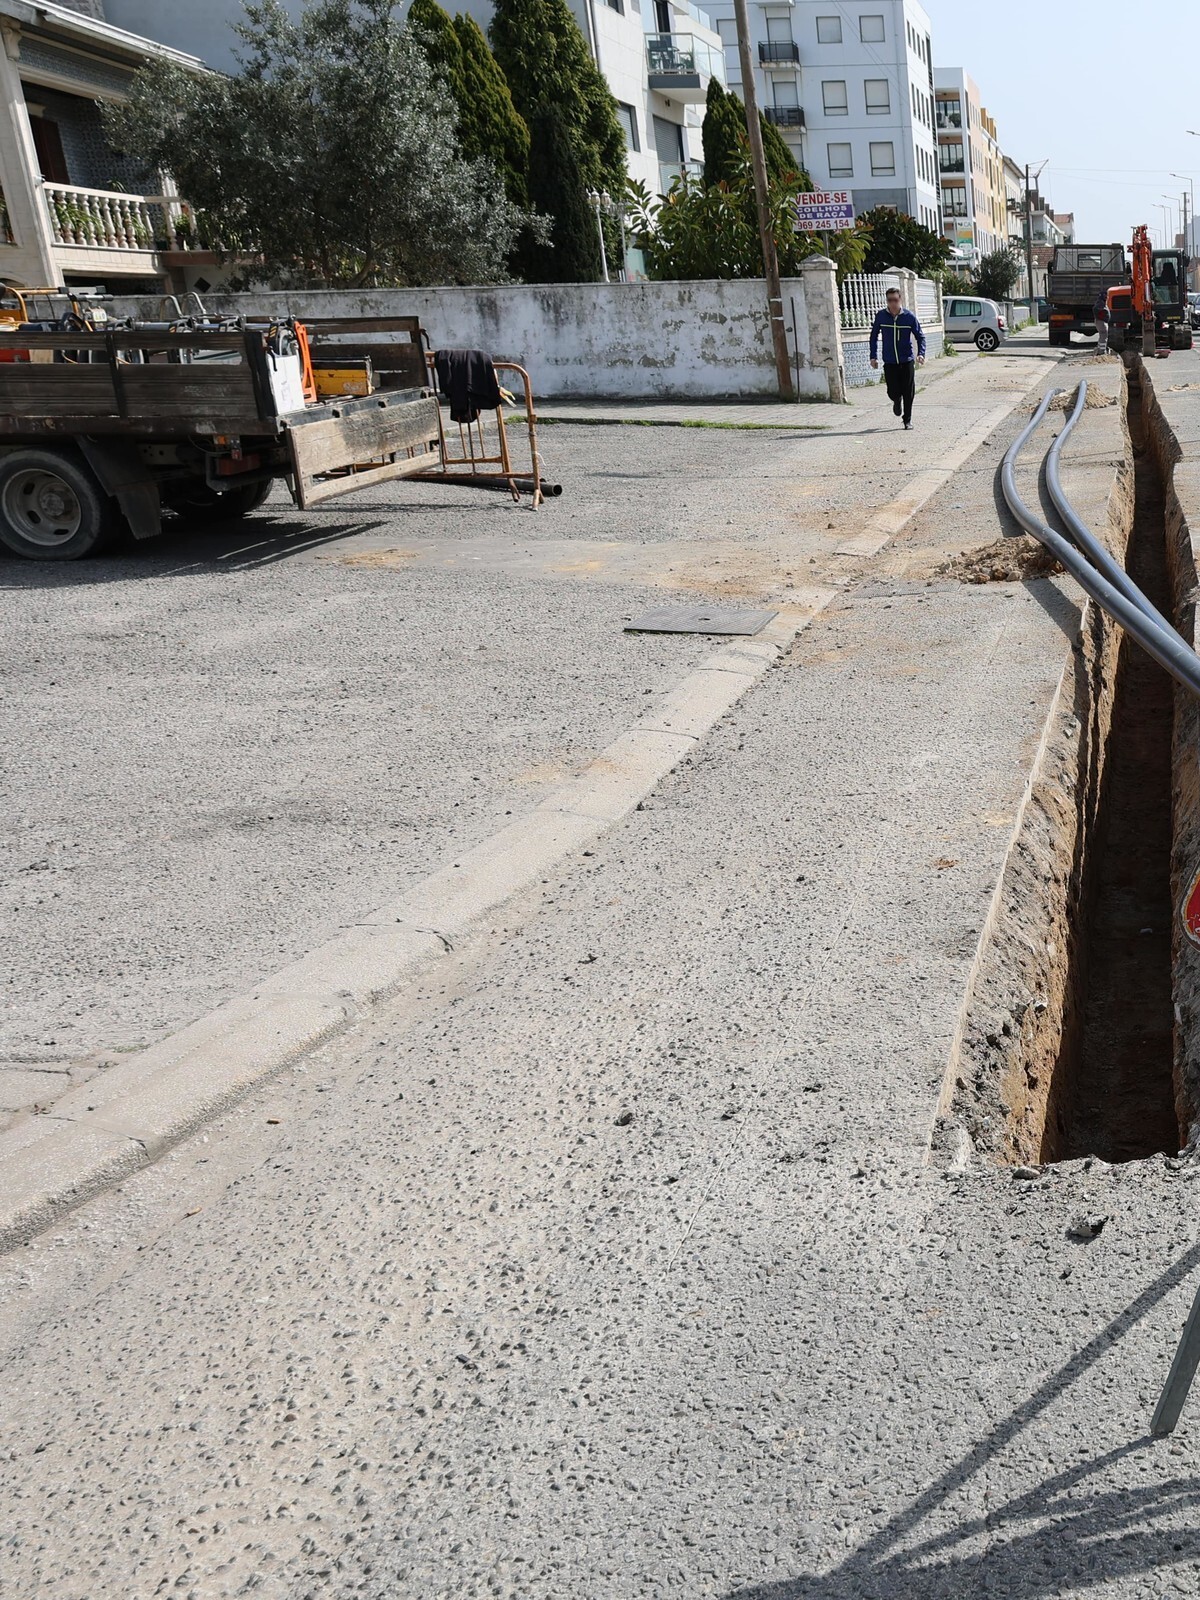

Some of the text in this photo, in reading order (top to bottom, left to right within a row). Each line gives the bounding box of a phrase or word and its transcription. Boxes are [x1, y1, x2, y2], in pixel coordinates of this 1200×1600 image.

[796, 192, 848, 205] VENDE-SE
[798, 219, 849, 230] 969 245 154
